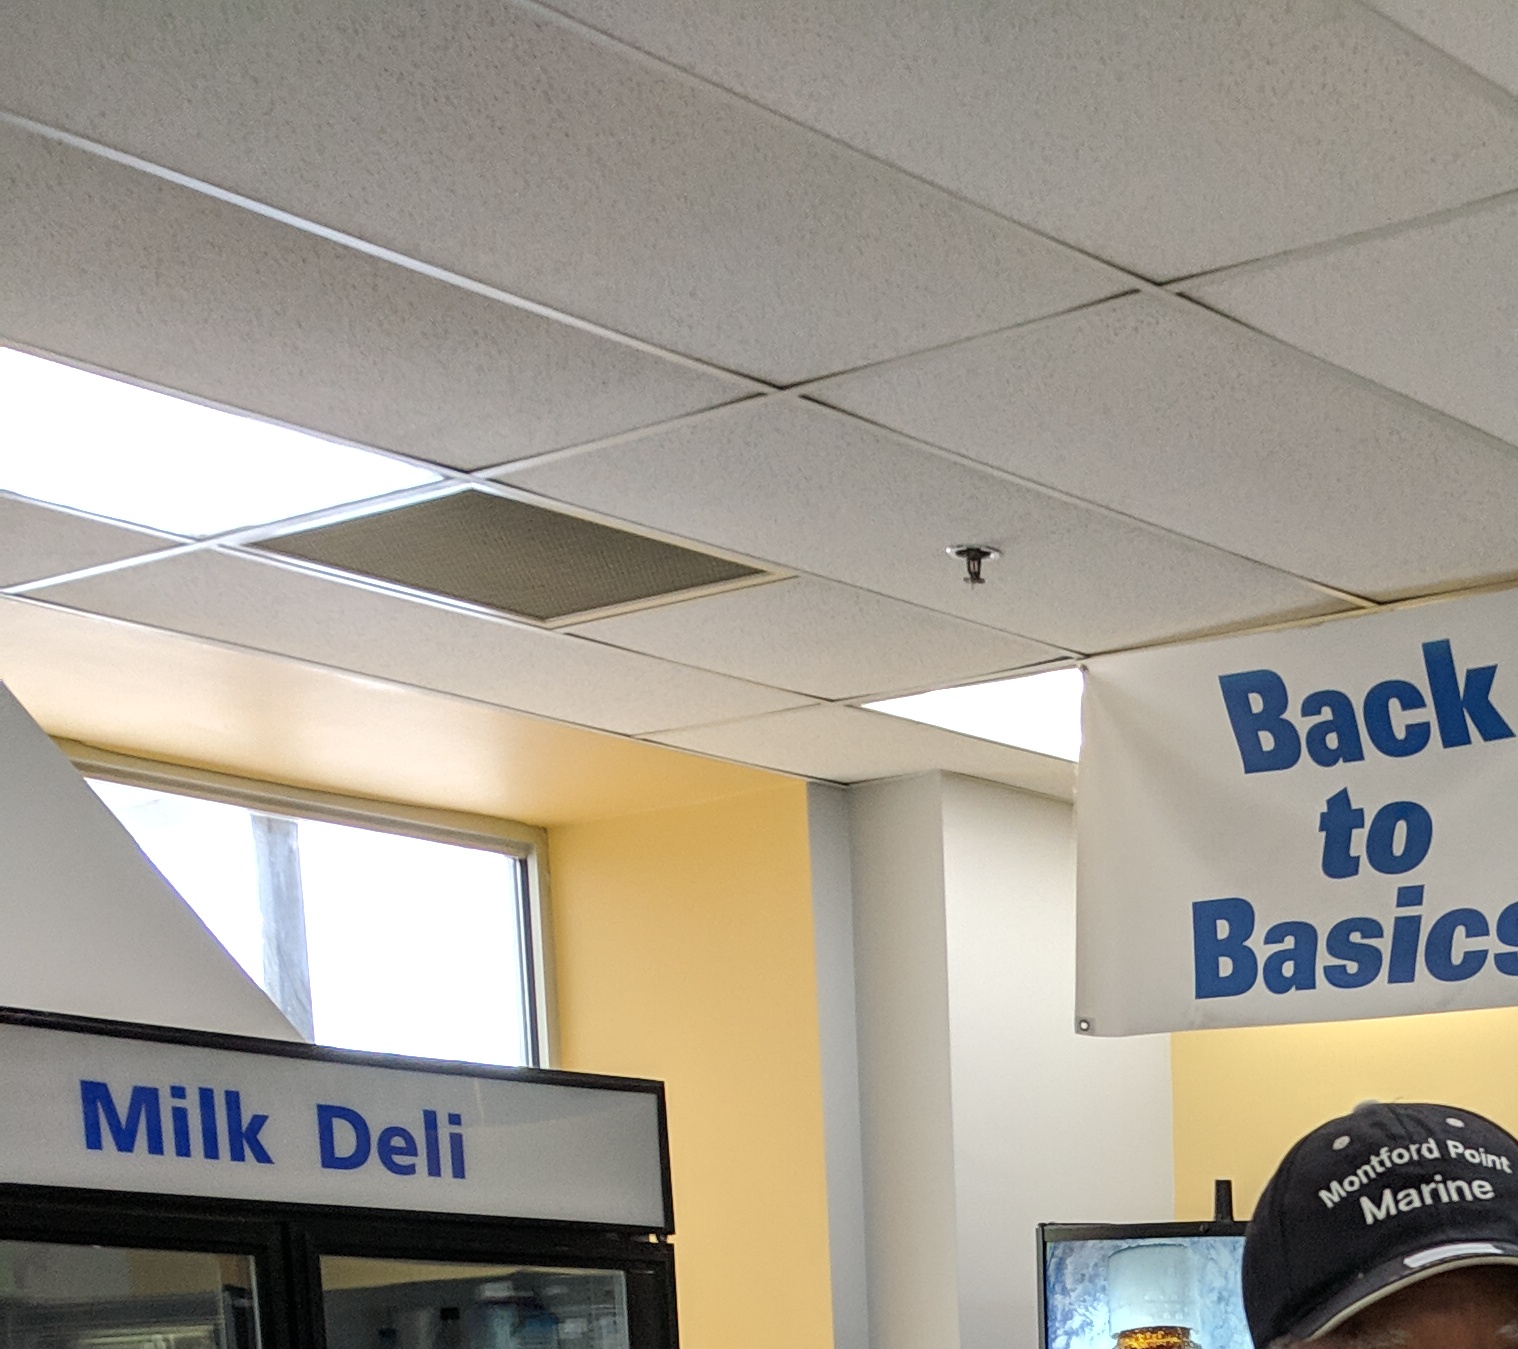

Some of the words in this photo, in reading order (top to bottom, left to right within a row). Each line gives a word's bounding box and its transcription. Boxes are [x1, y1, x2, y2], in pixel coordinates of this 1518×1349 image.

[1218, 638, 1516, 774] Back
[1319, 787, 1433, 879] to
[79, 1079, 274, 1165] Milk
[316, 1103, 467, 1179] Deli
[1318, 1138, 1441, 1209] Montford
[1445, 1139, 1513, 1174] Point
[1359, 1174, 1495, 1225] Marine
